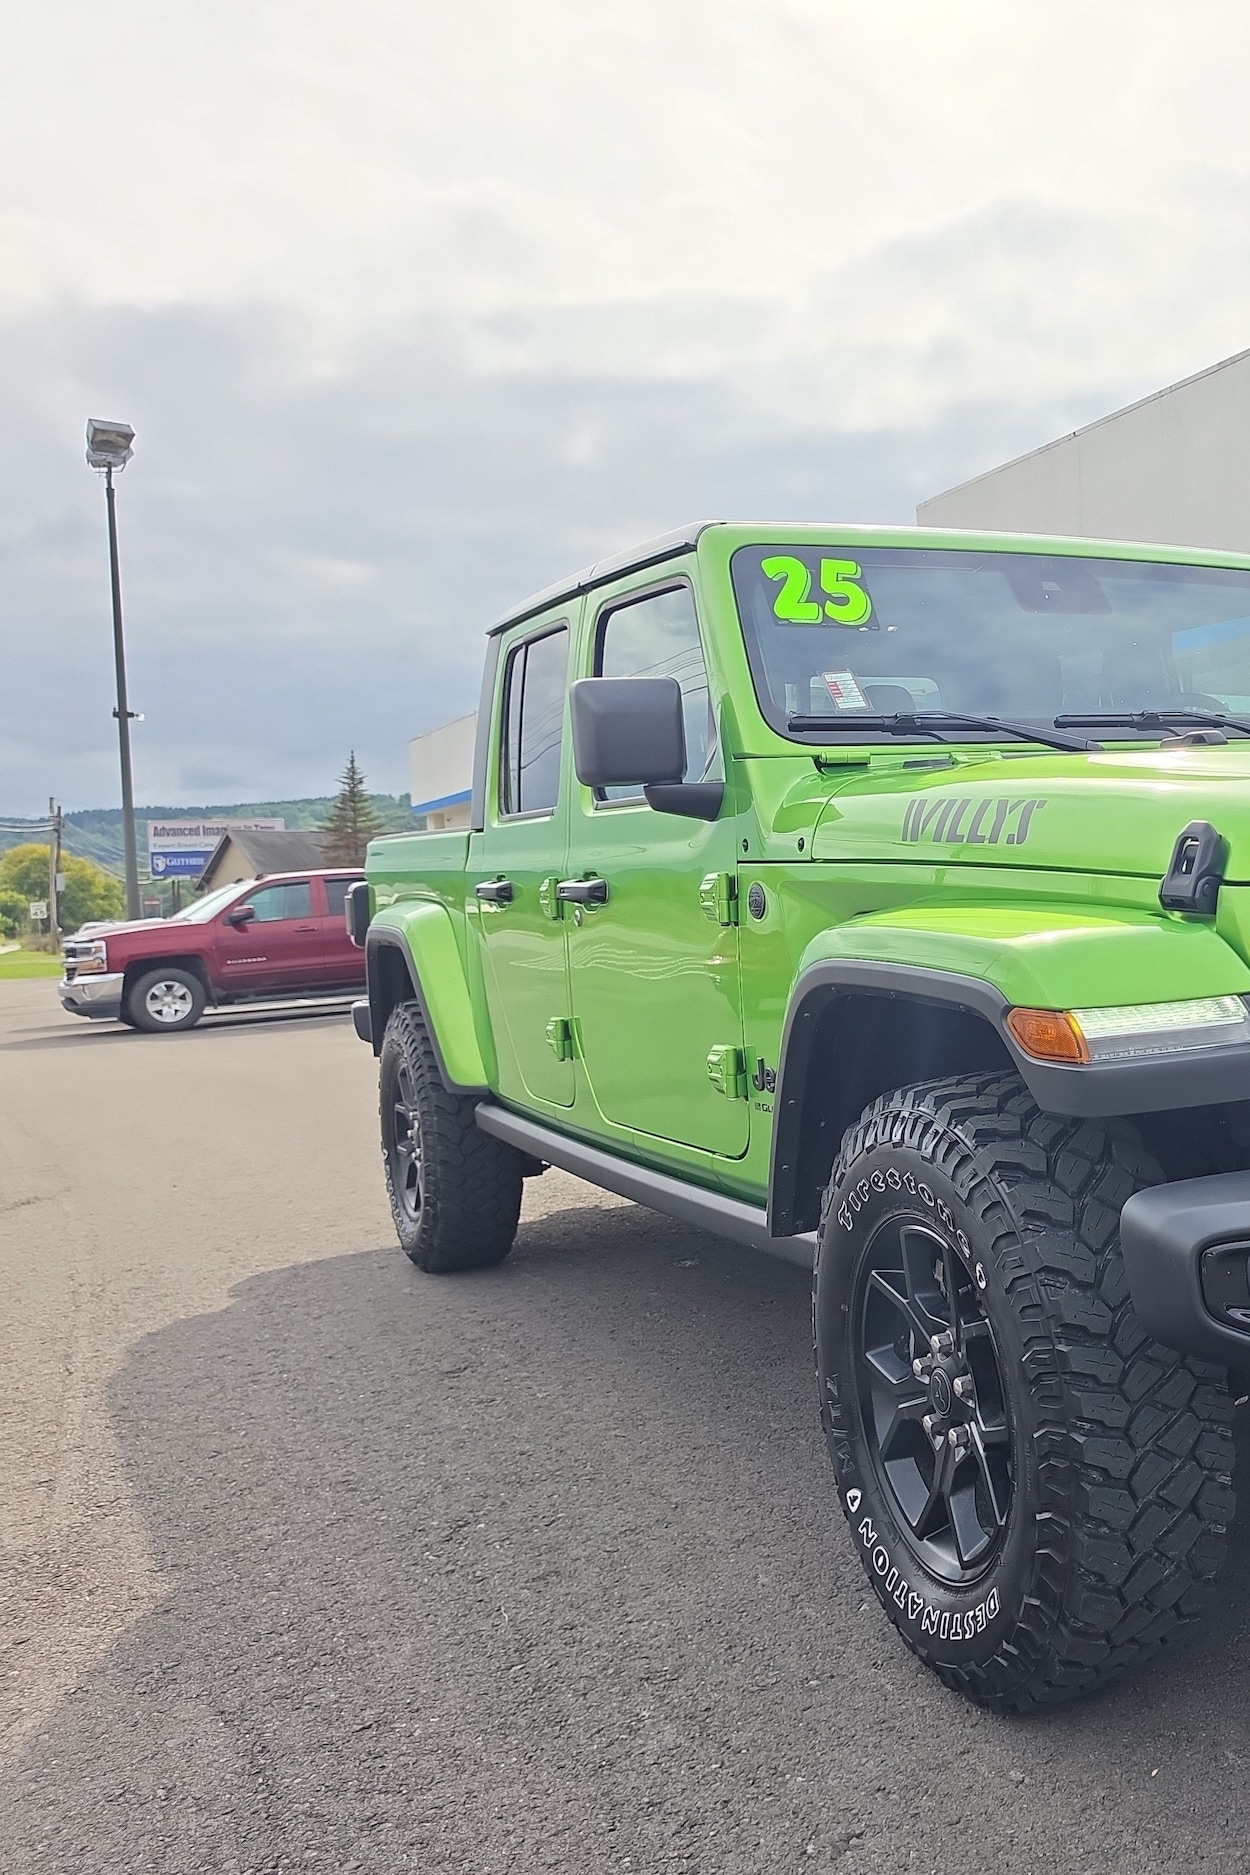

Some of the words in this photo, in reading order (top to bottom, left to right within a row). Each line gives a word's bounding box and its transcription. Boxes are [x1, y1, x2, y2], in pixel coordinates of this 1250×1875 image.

[760, 555, 872, 626] 25
[153, 825, 200, 837] Advanced
[901, 799, 1047, 844] WILLYS
[752, 1057, 776, 1093] Je
[838, 1167, 971, 1258] Firestone
[858, 1517, 1000, 1640] DESTINATION
